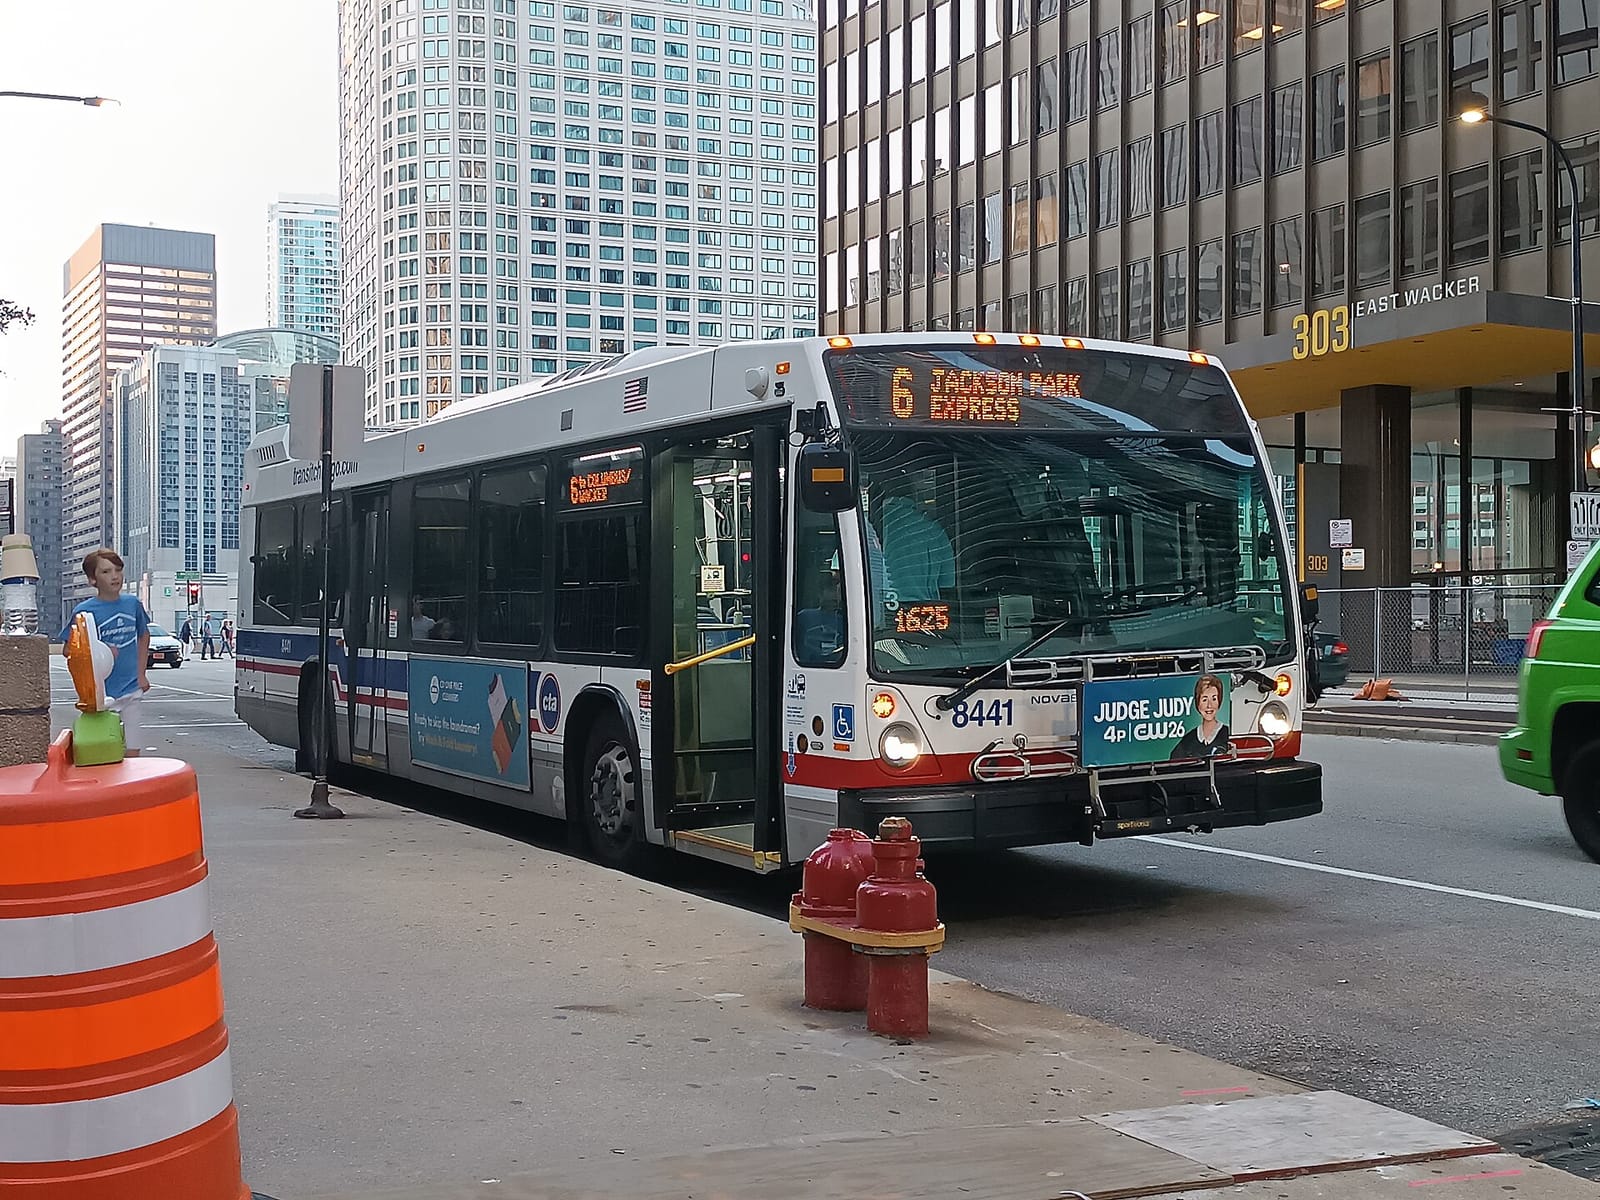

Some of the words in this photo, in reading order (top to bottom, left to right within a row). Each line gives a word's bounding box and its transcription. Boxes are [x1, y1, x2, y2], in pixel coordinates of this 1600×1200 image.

[1292, 305, 1350, 360] 303
[1356, 293, 1399, 317] EAST
[1404, 276, 1480, 307] WACKER
[892, 367, 914, 419] 6
[931, 368, 1023, 396] JACKSON
[1030, 372, 1081, 398] PARK
[930, 395, 1020, 421] EXPRESS
[1308, 555, 1328, 571] 303
[884, 591, 900, 611] 3
[543, 692, 557, 712] cta
[951, 698, 1014, 729] 8441
[1093, 699, 1150, 723] JUDGE
[1153, 696, 1194, 719] JUDY
